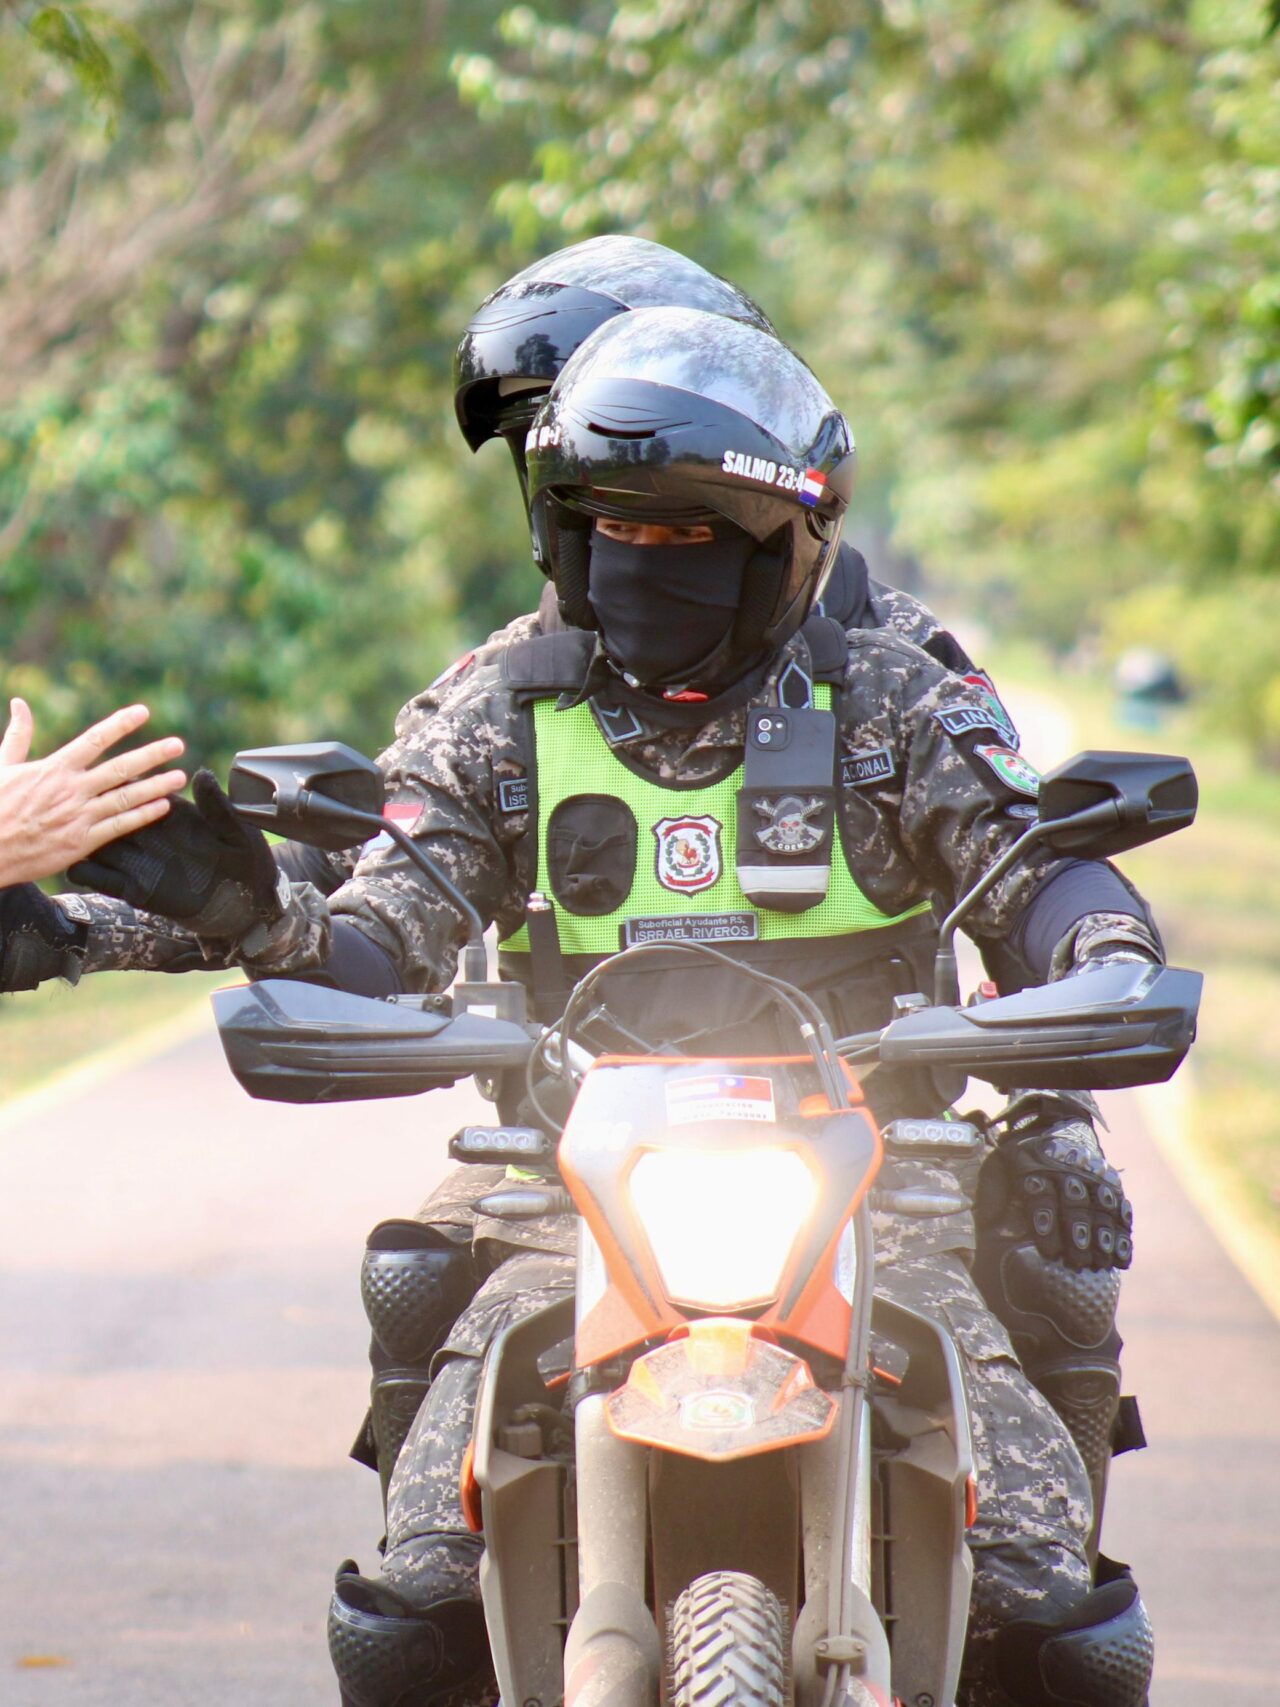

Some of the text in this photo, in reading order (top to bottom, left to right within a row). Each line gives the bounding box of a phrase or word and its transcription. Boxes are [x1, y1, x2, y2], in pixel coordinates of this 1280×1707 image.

[722, 450, 806, 492] SALMO 23:4
[638, 918, 683, 929] Suboficial
[685, 917, 728, 928] Ayudante
[634, 925, 749, 942] ISRRAEL RIVEROS
